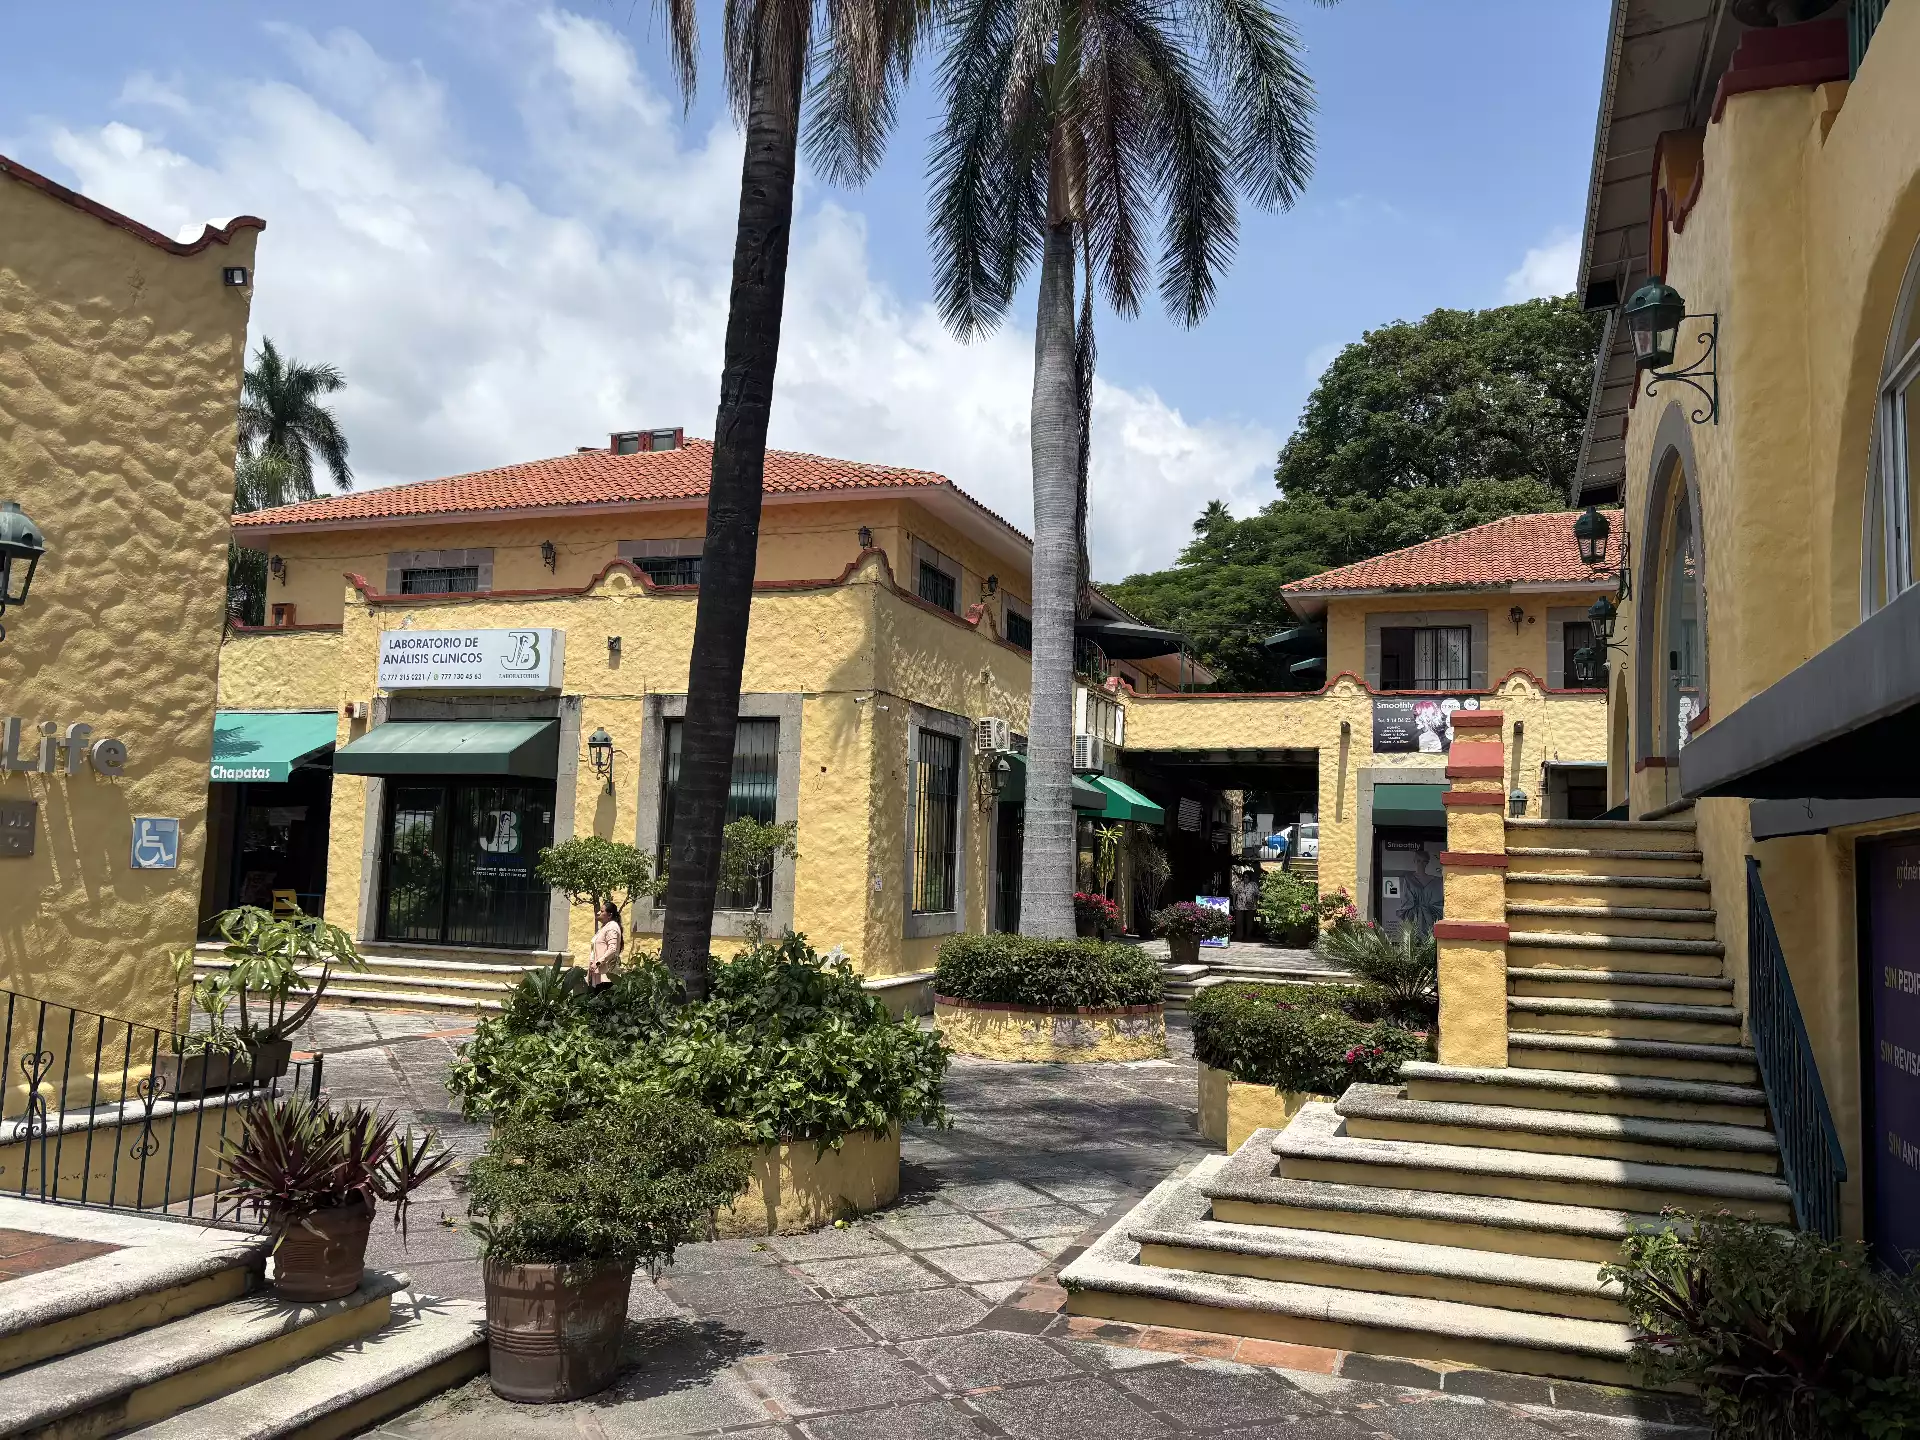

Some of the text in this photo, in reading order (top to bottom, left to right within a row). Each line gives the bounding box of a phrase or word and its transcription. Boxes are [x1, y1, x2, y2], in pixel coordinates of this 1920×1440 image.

[389, 637, 479, 650] LABORATORIO DE
[383, 652, 483, 665] ANÁLISIS CLINICOS
[1376, 701, 1414, 711] Smoothly
[2, 716, 128, 777] Life
[210, 765, 271, 780] Chapatas
[1387, 841, 1421, 851] Smoothly
[1884, 965, 1897, 989] SIN
[1880, 1039, 1893, 1065] SIN
[1888, 1131, 1902, 1159] SIN
